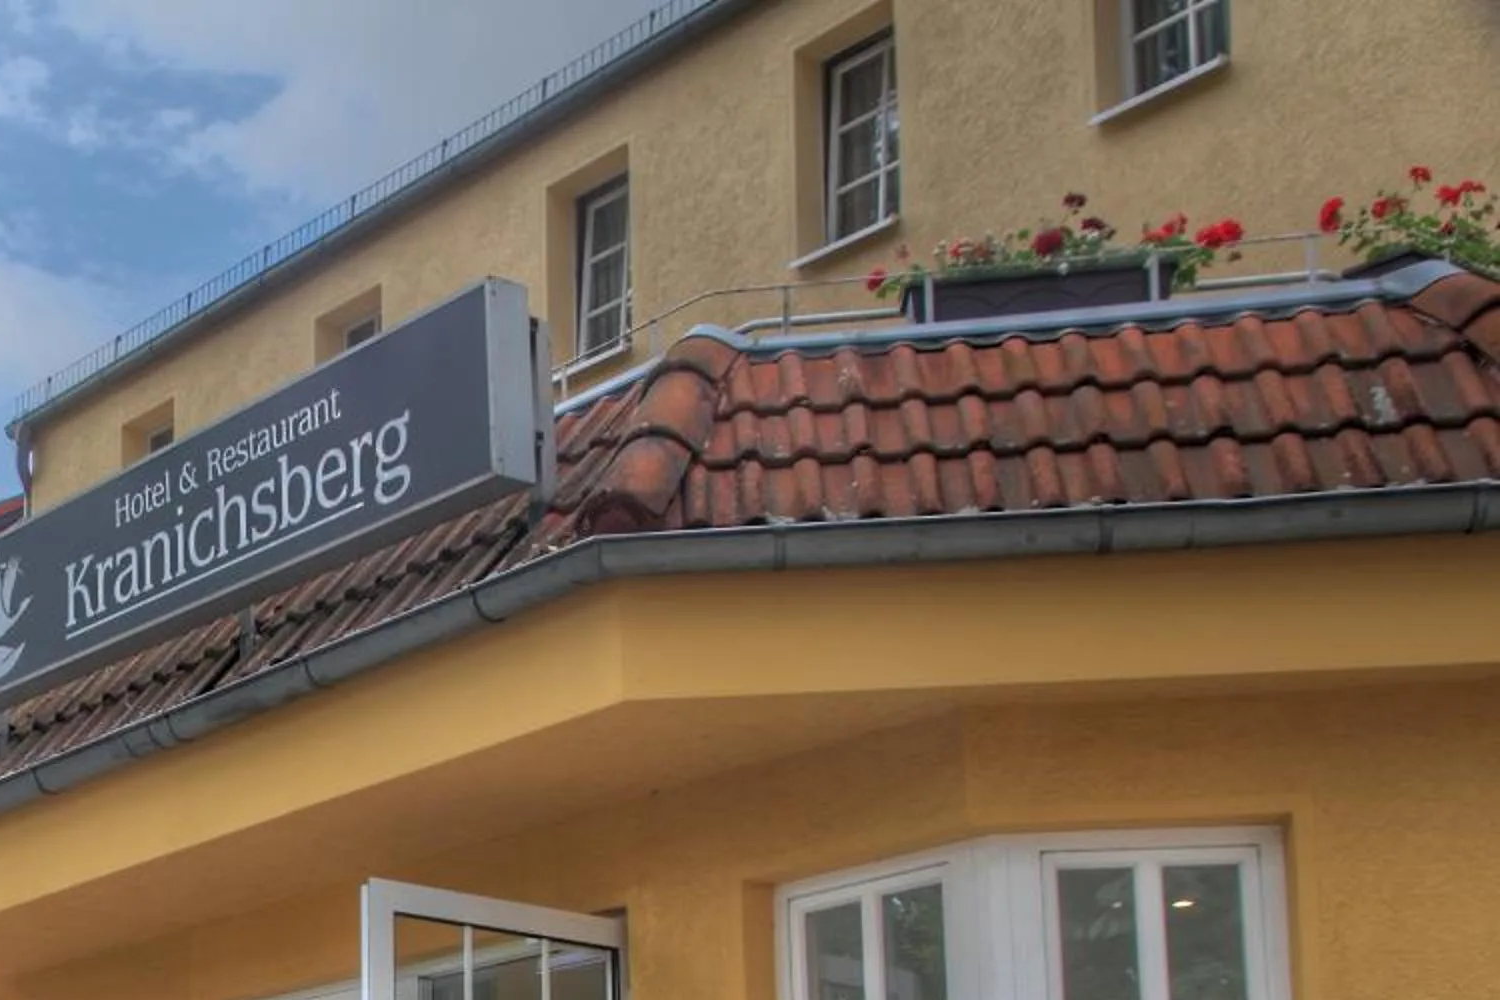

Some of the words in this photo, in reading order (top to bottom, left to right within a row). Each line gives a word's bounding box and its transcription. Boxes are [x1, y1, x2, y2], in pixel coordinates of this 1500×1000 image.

[63, 408, 414, 628] Kranichsberg
[113, 464, 171, 529] Hotel
[178, 459, 199, 494] &
[205, 386, 342, 483] Restaurant
